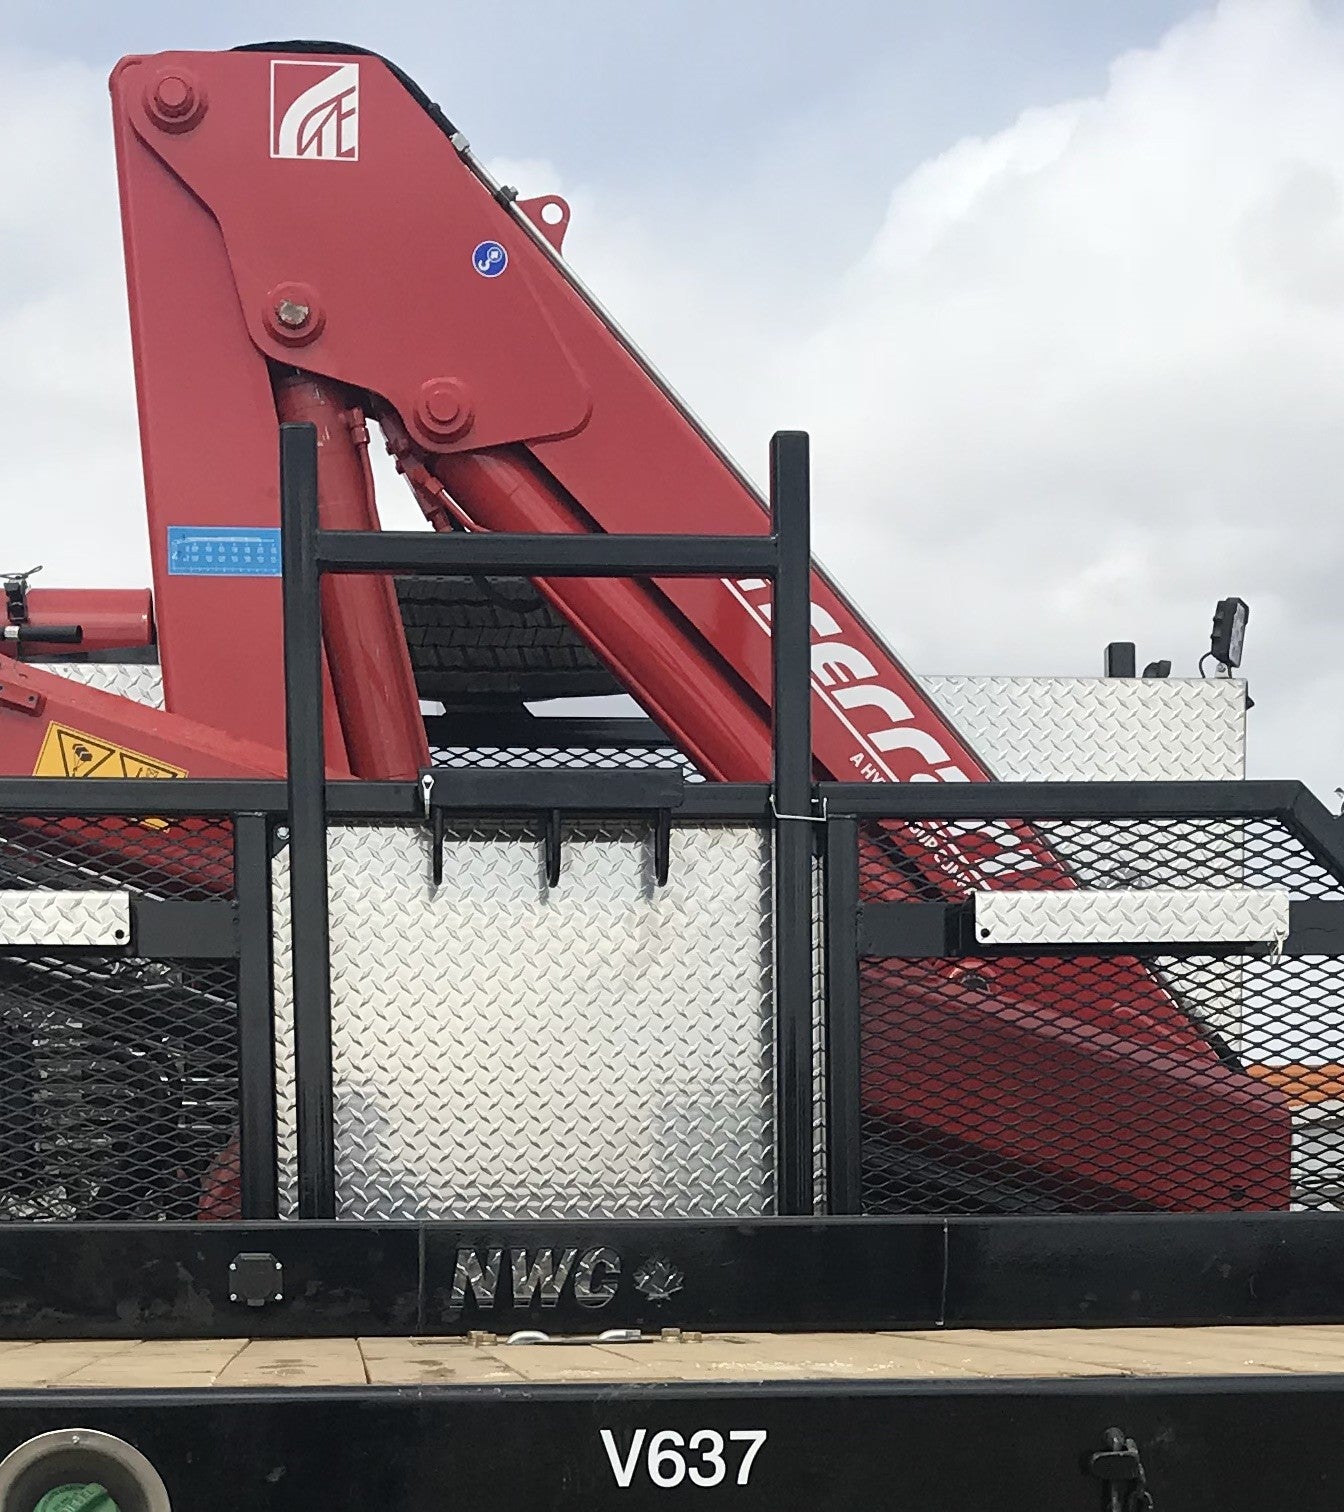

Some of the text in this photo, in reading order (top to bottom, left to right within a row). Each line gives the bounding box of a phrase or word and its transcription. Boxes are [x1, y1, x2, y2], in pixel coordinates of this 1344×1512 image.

[849, 752, 865, 768] A
[450, 1246, 622, 1308] NWC
[599, 1428, 767, 1488] V637
